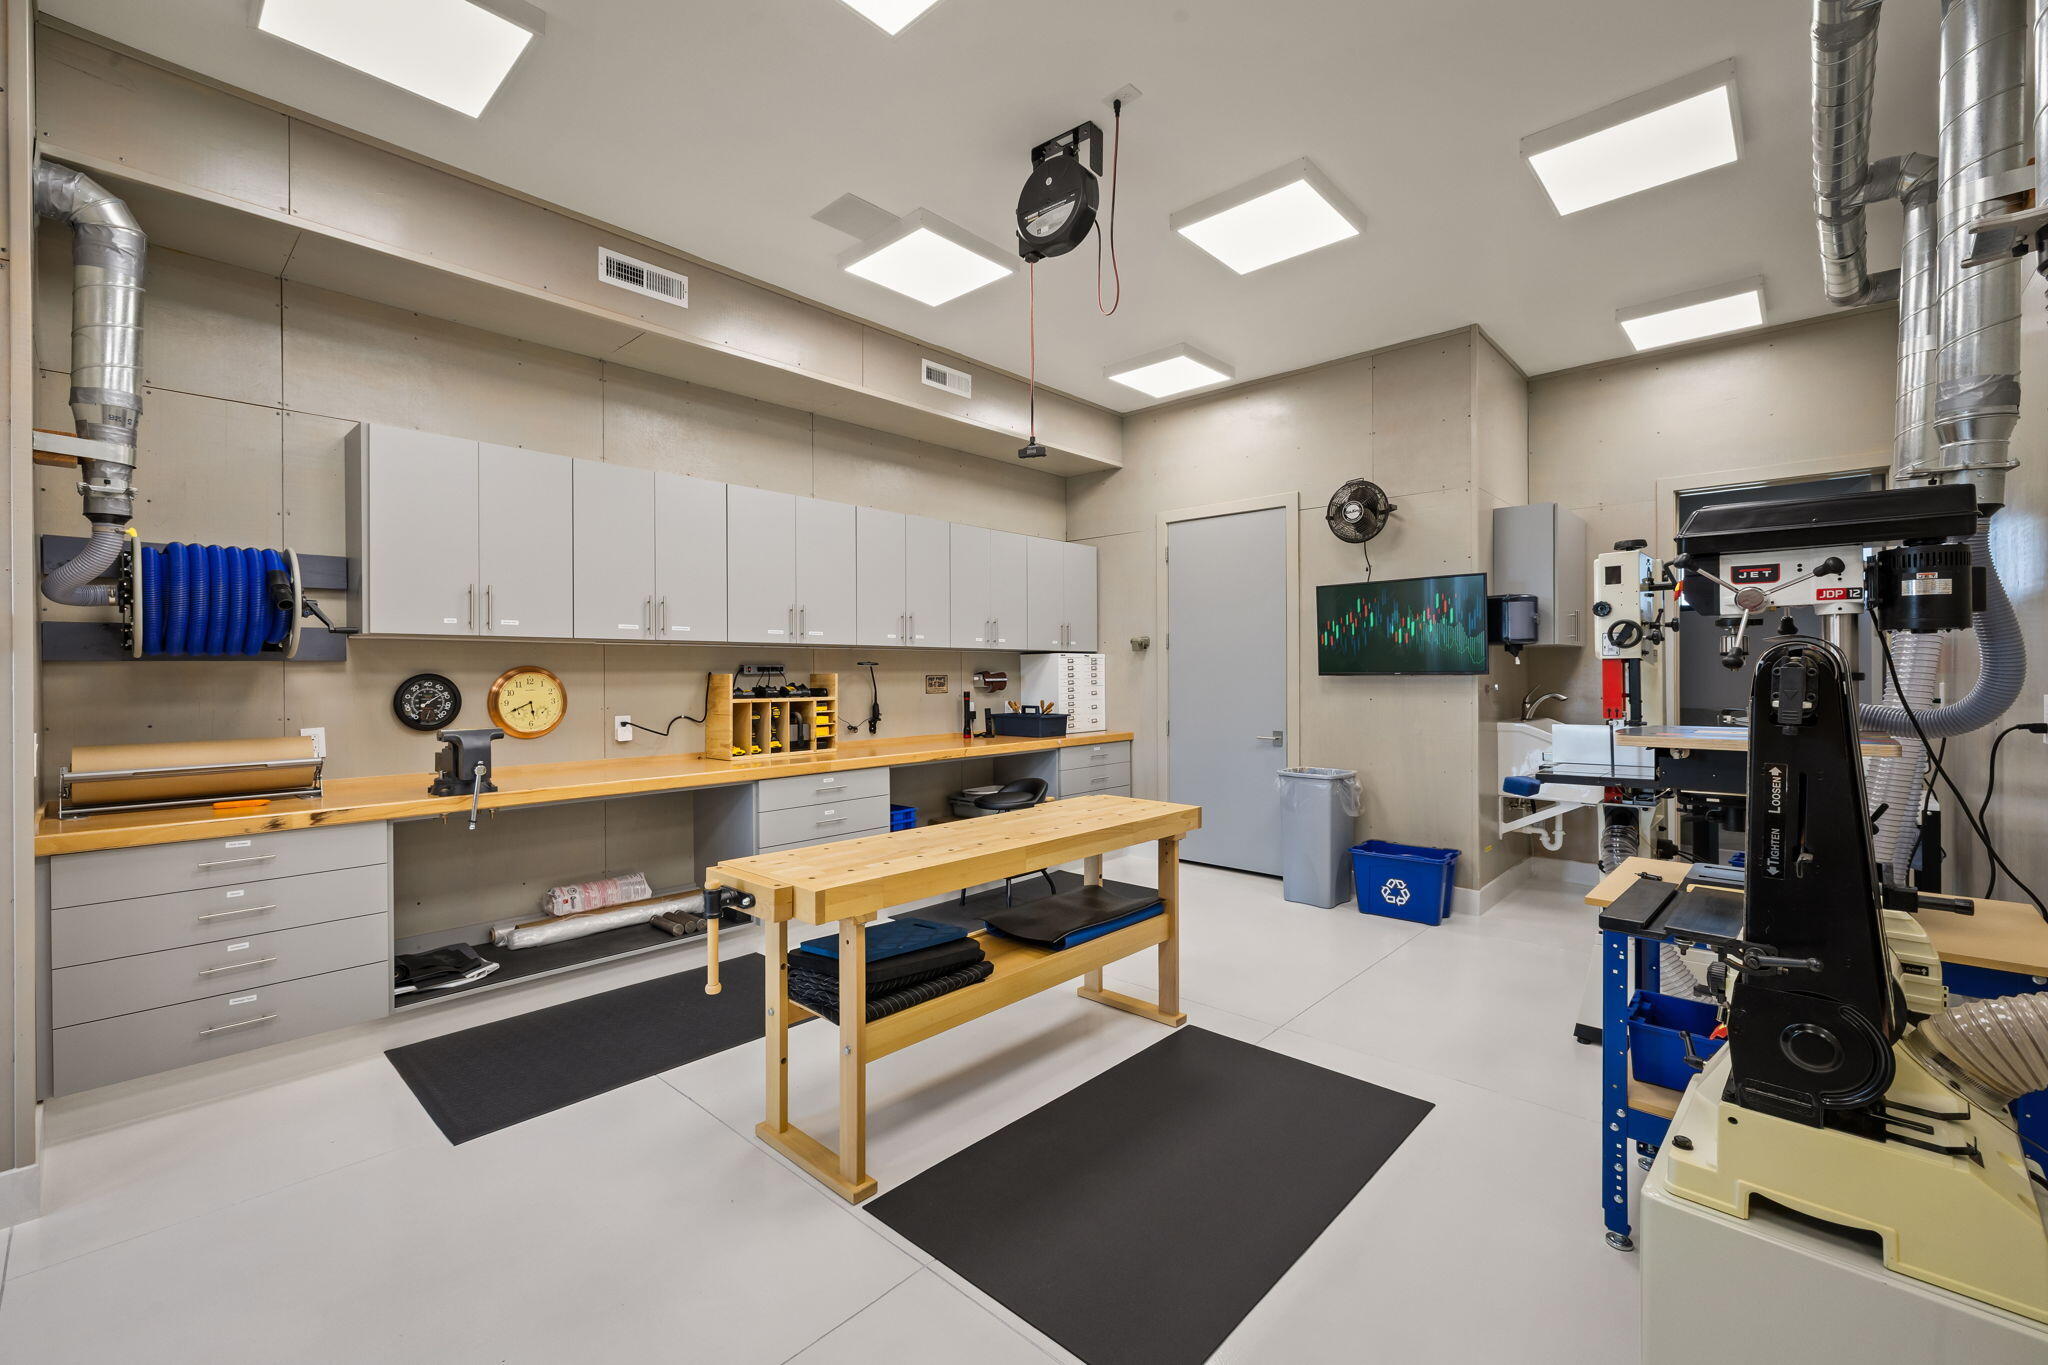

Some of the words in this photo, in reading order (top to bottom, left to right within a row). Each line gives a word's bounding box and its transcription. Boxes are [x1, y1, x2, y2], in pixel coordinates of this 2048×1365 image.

[1738, 570, 1772, 579] JET
[1819, 589, 1844, 599] JDP
[1849, 589, 1861, 598] 12
[410, 684, 420, 692] 20
[442, 691, 451, 700] 80
[507, 689, 515, 697] 10
[1768, 776, 1782, 814] LOOSEN
[1767, 828, 1780, 866] TIGHTEN
